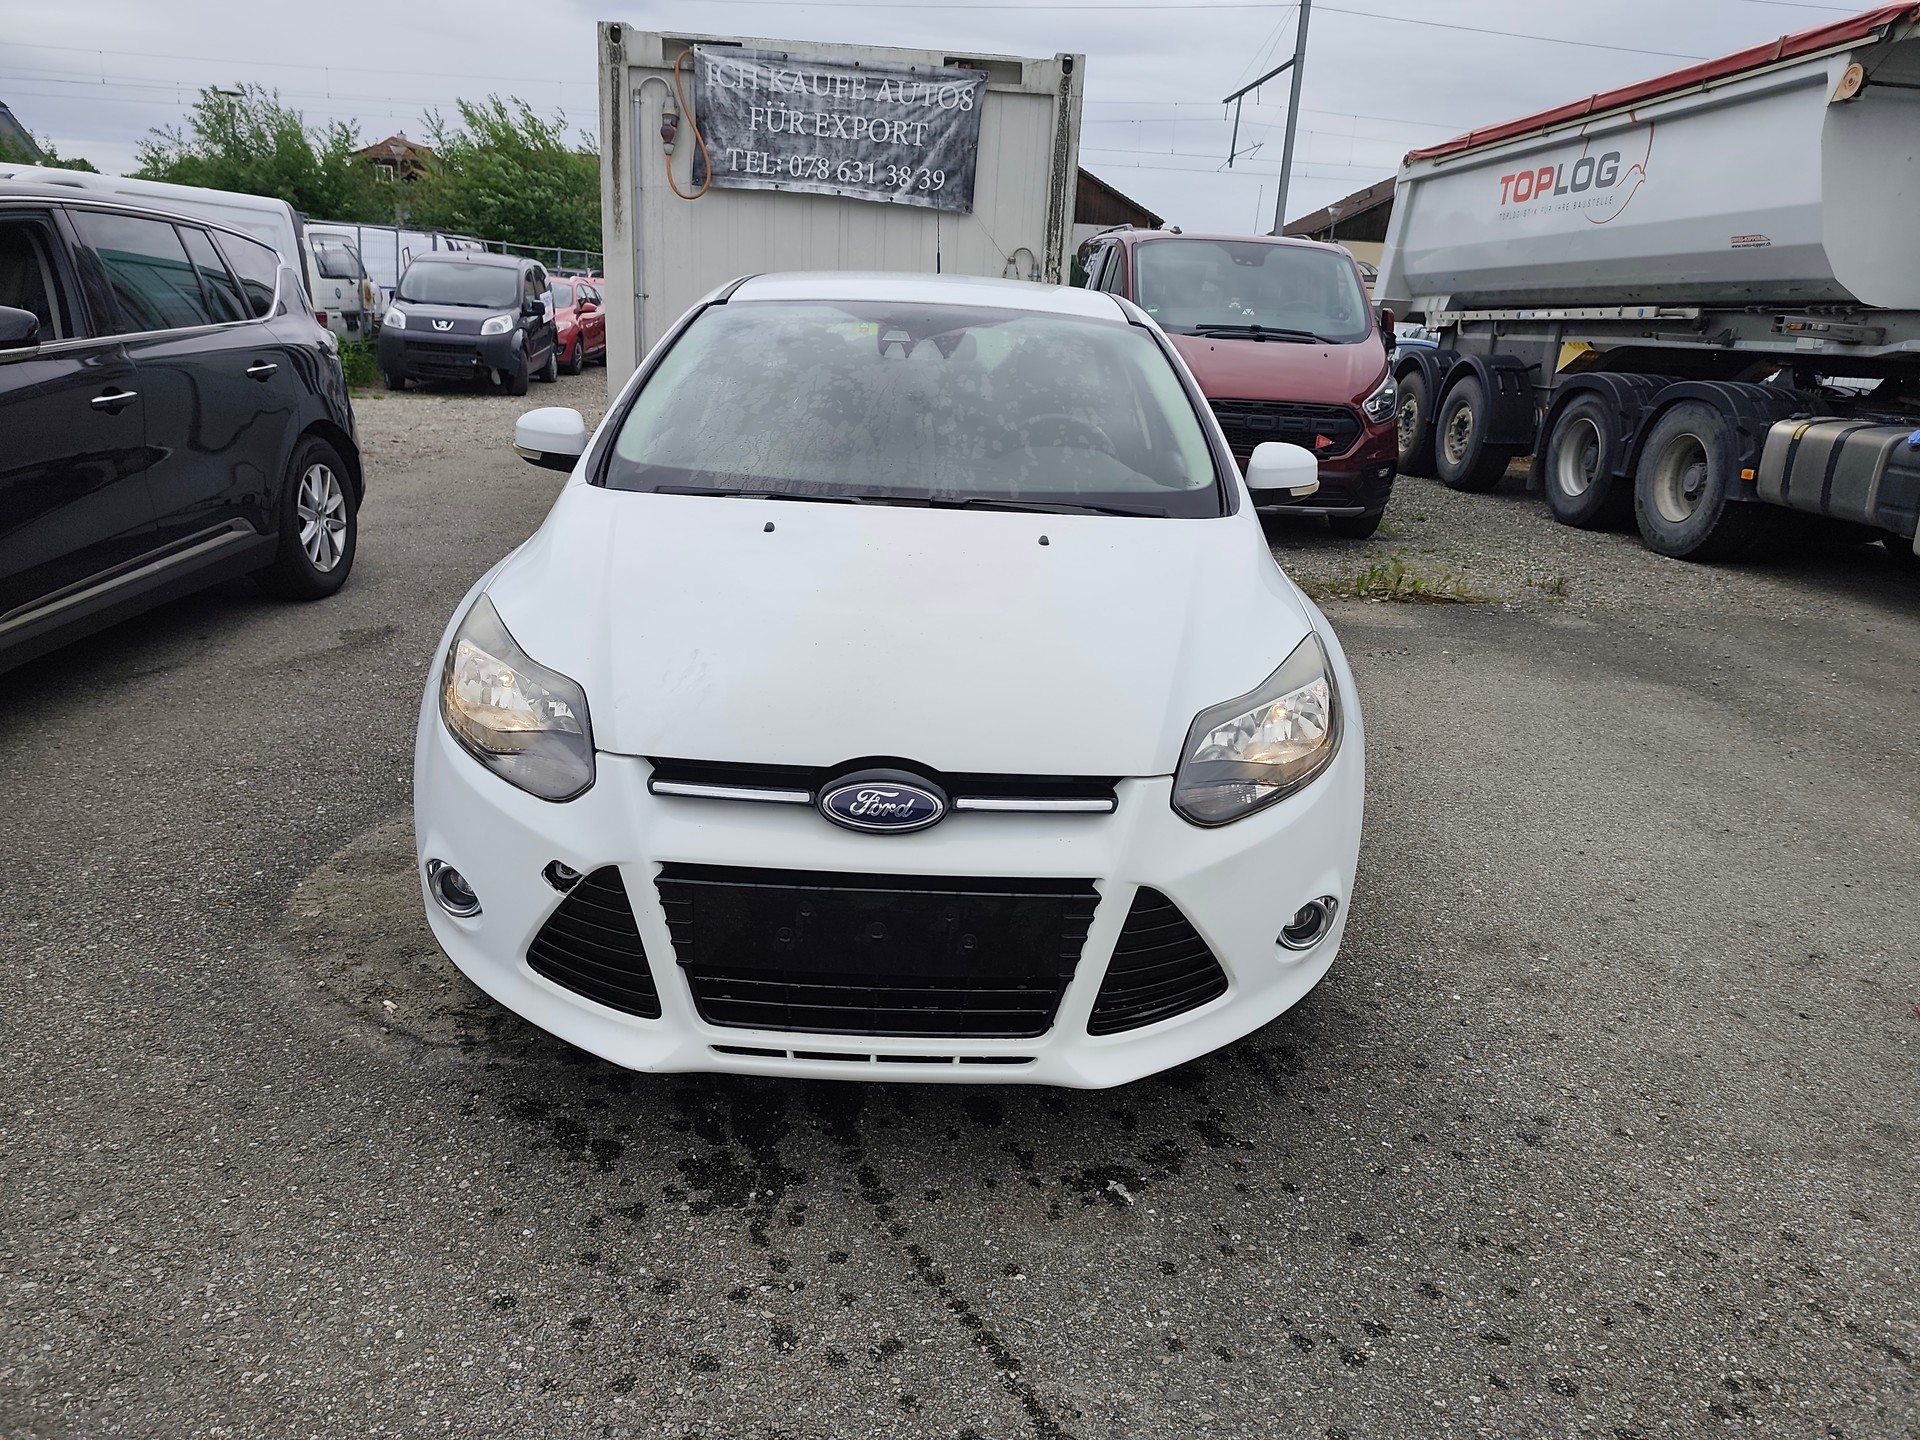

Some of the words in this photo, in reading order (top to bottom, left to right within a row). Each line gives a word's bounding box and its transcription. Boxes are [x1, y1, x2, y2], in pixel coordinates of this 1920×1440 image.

[706, 62, 758, 90] ICH
[769, 67, 867, 101] KAUFE
[874, 78, 974, 112] AUTOS
[749, 100, 806, 135] FÜR
[814, 112, 929, 147] EXPORT
[726, 149, 782, 175] TEL:
[789, 155, 830, 180] 078
[837, 160, 876, 184] 631
[885, 164, 911, 187] 38
[918, 168, 945, 191] 39
[1500, 151, 1621, 206] TOPLOG
[1572, 195, 1614, 210] BAUSTELLE
[850, 789, 915, 817] Ford
